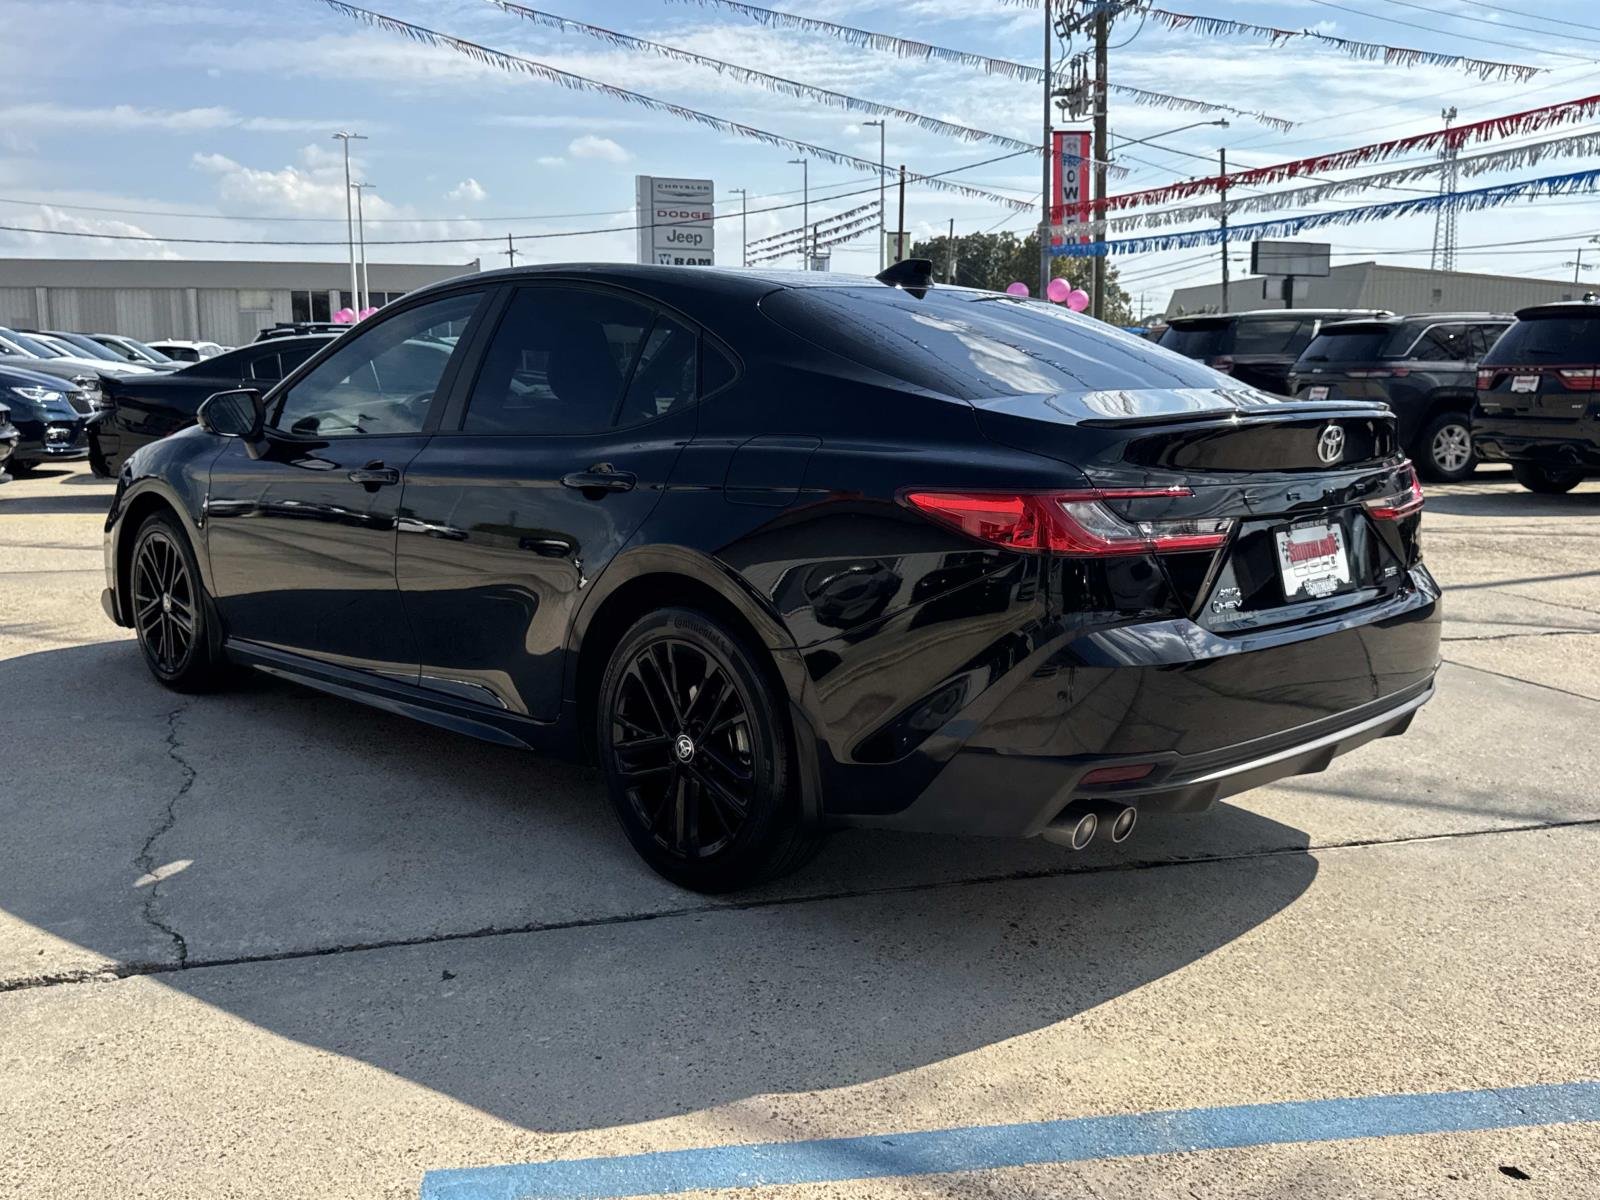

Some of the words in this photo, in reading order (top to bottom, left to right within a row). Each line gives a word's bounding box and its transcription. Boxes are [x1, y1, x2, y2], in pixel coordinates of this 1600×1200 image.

[657, 183, 710, 191] CHRYSLER
[657, 210, 712, 220] DODGE
[666, 229, 703, 246] Jeep
[674, 258, 711, 266] RAM
[1218, 599, 1243, 610] HEV
